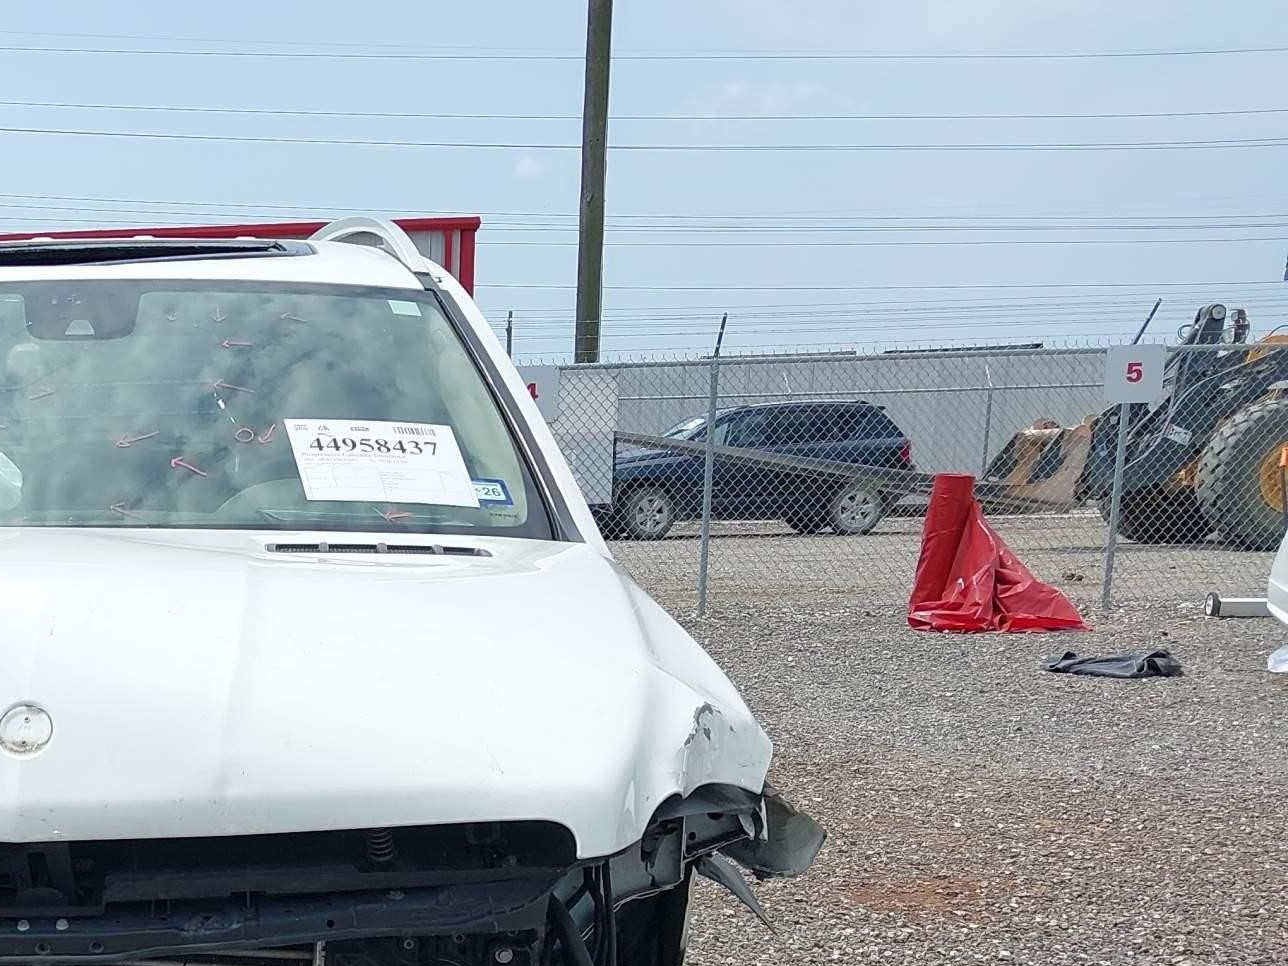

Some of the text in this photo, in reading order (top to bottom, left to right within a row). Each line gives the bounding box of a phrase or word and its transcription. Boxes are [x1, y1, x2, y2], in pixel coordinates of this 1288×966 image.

[1126, 362, 1143, 382] 5
[309, 437, 438, 456] 44958437
[482, 487, 501, 497] 26
